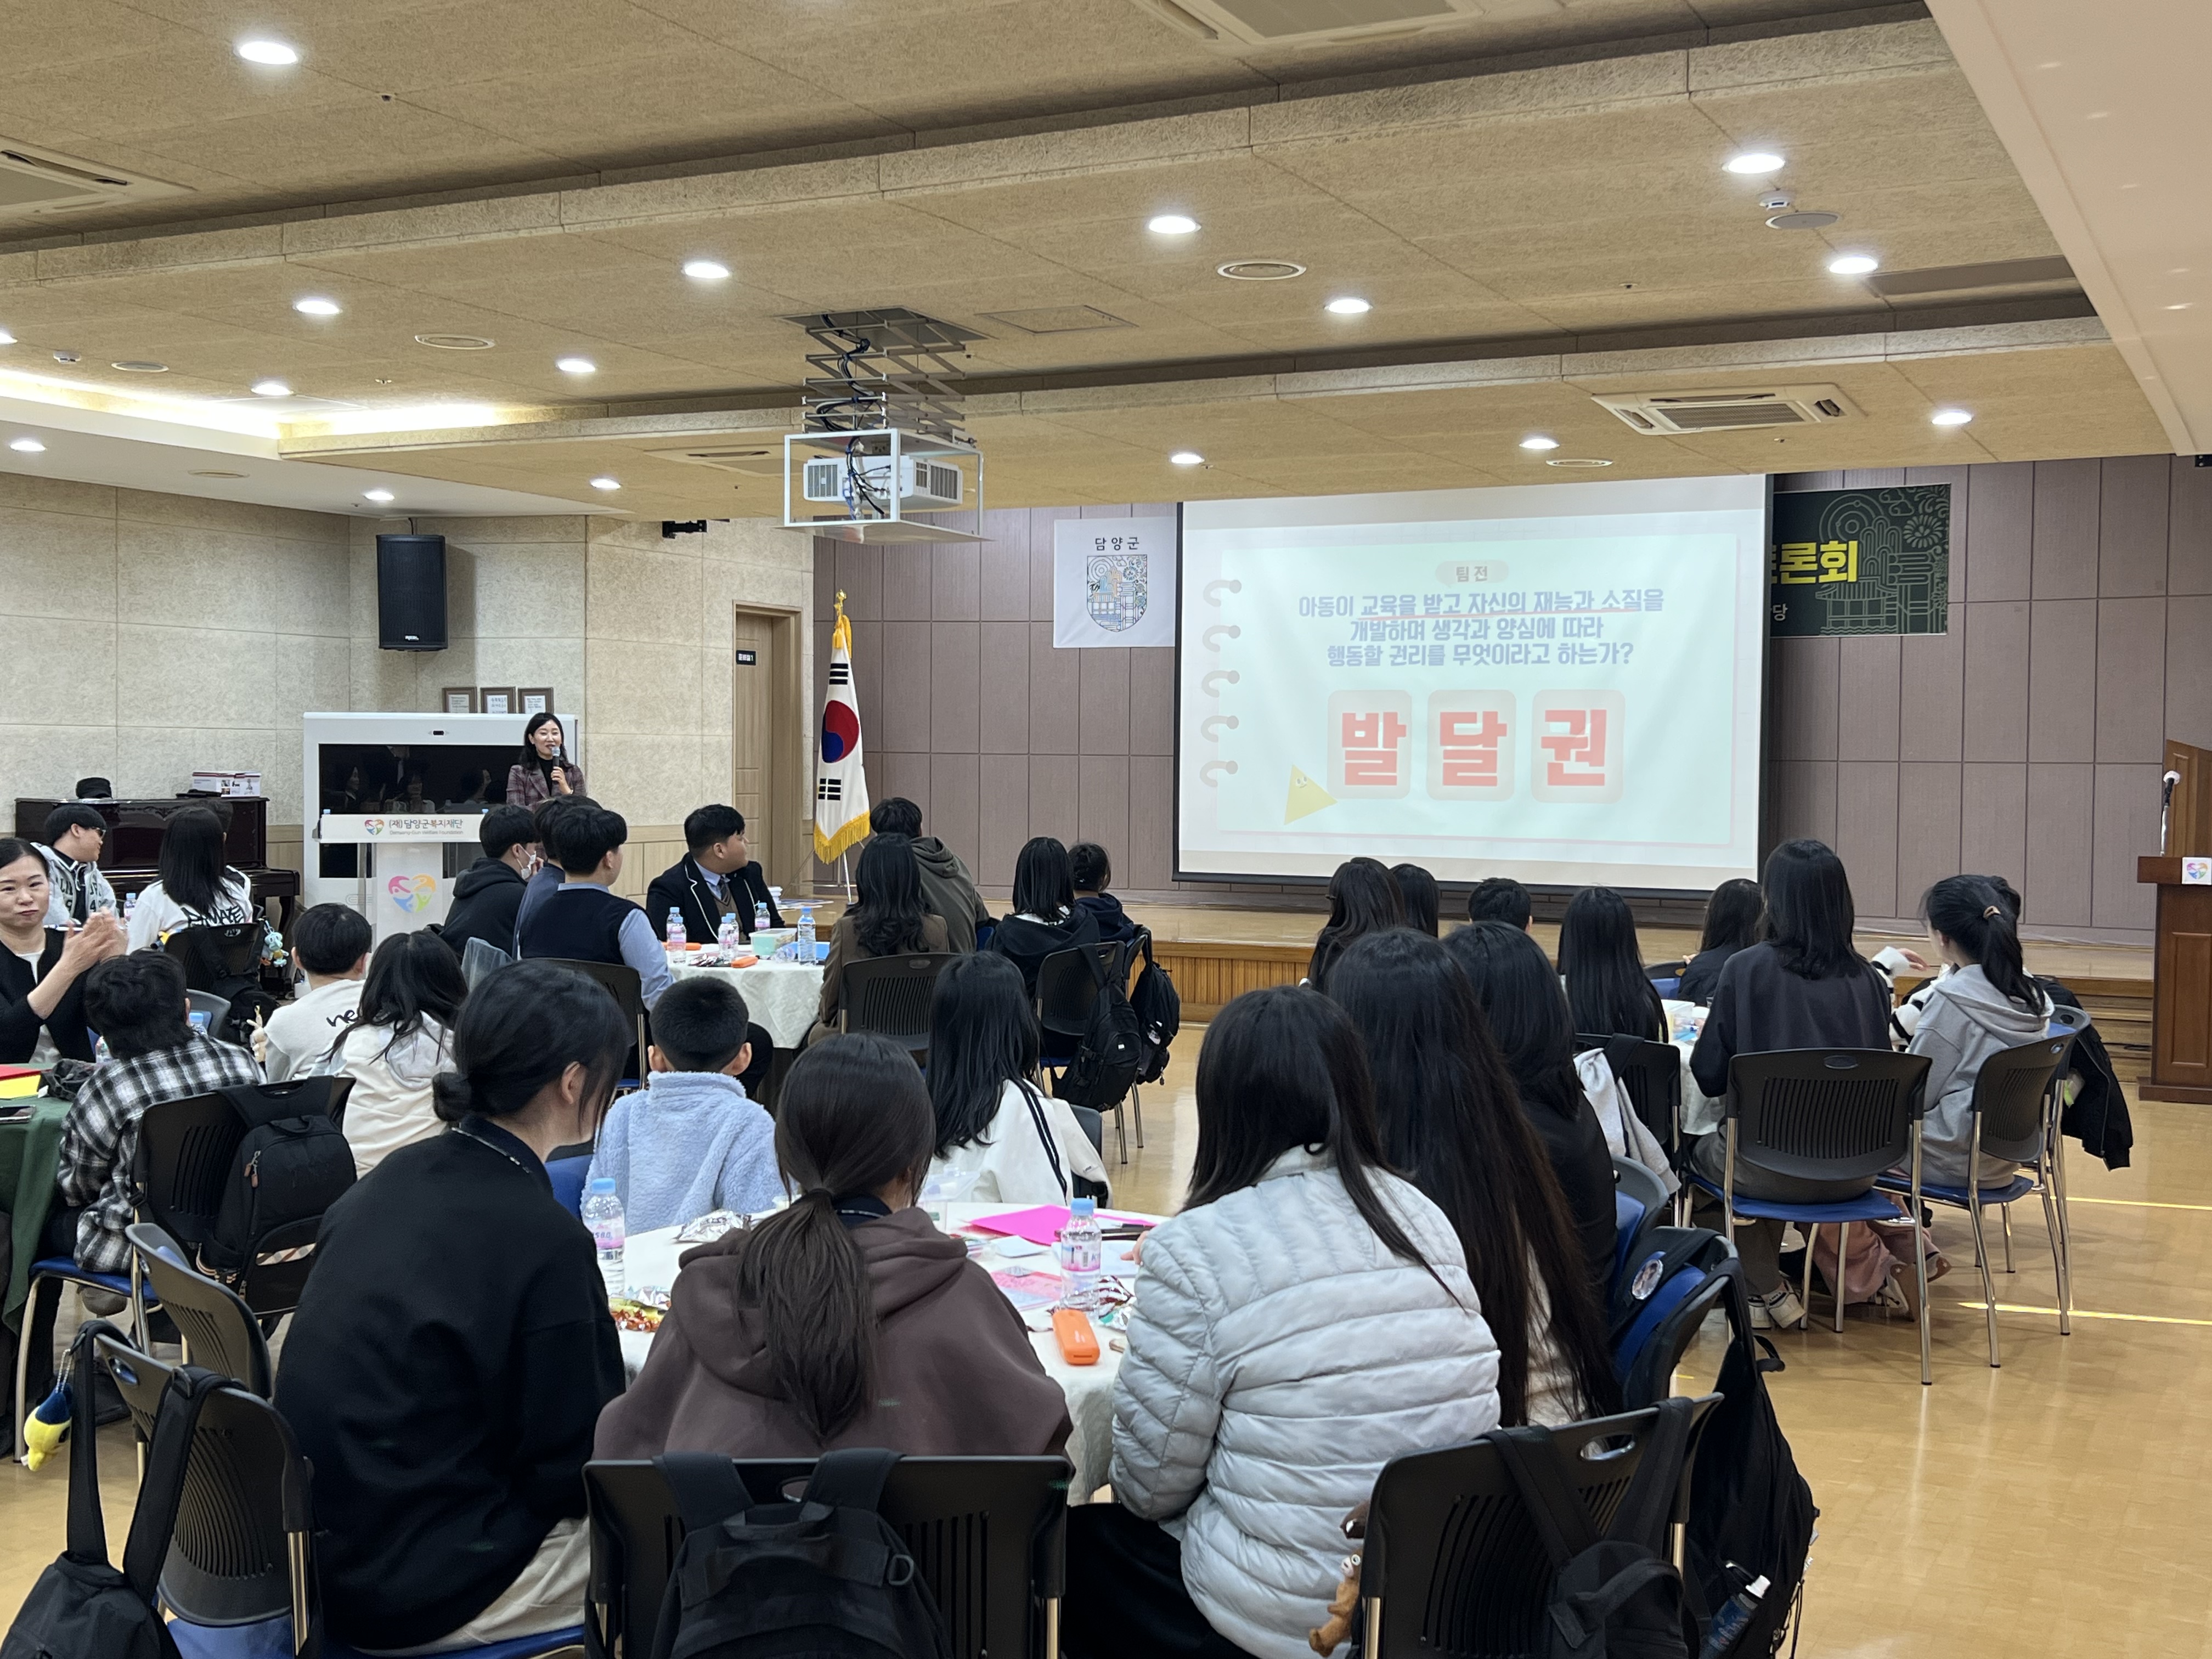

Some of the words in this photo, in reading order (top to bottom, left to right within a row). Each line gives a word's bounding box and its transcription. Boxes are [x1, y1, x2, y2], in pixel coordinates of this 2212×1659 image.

[1095, 537, 1139, 551] 담양군
[1771, 540, 1858, 584] 론회
[1299, 596, 1354, 618] 아동이
[1361, 595, 1416, 616] 교육을
[1424, 594, 1461, 614] 받고
[1468, 592, 1526, 614] 자신의
[1534, 590, 1594, 612] 재능과
[1601, 589, 1663, 611] 소질을
[1770, 603, 1788, 621] 당
[1350, 619, 1425, 641] 개발하며
[1432, 618, 1490, 640] 생각과
[1497, 617, 1555, 640] 양심에
[1563, 617, 1604, 638] 따라
[1327, 645, 1384, 667] 행동할
[1389, 644, 1445, 666] 권리를
[1452, 643, 1550, 665] 무엇이라고
[1558, 642, 1633, 664] 하는가?
